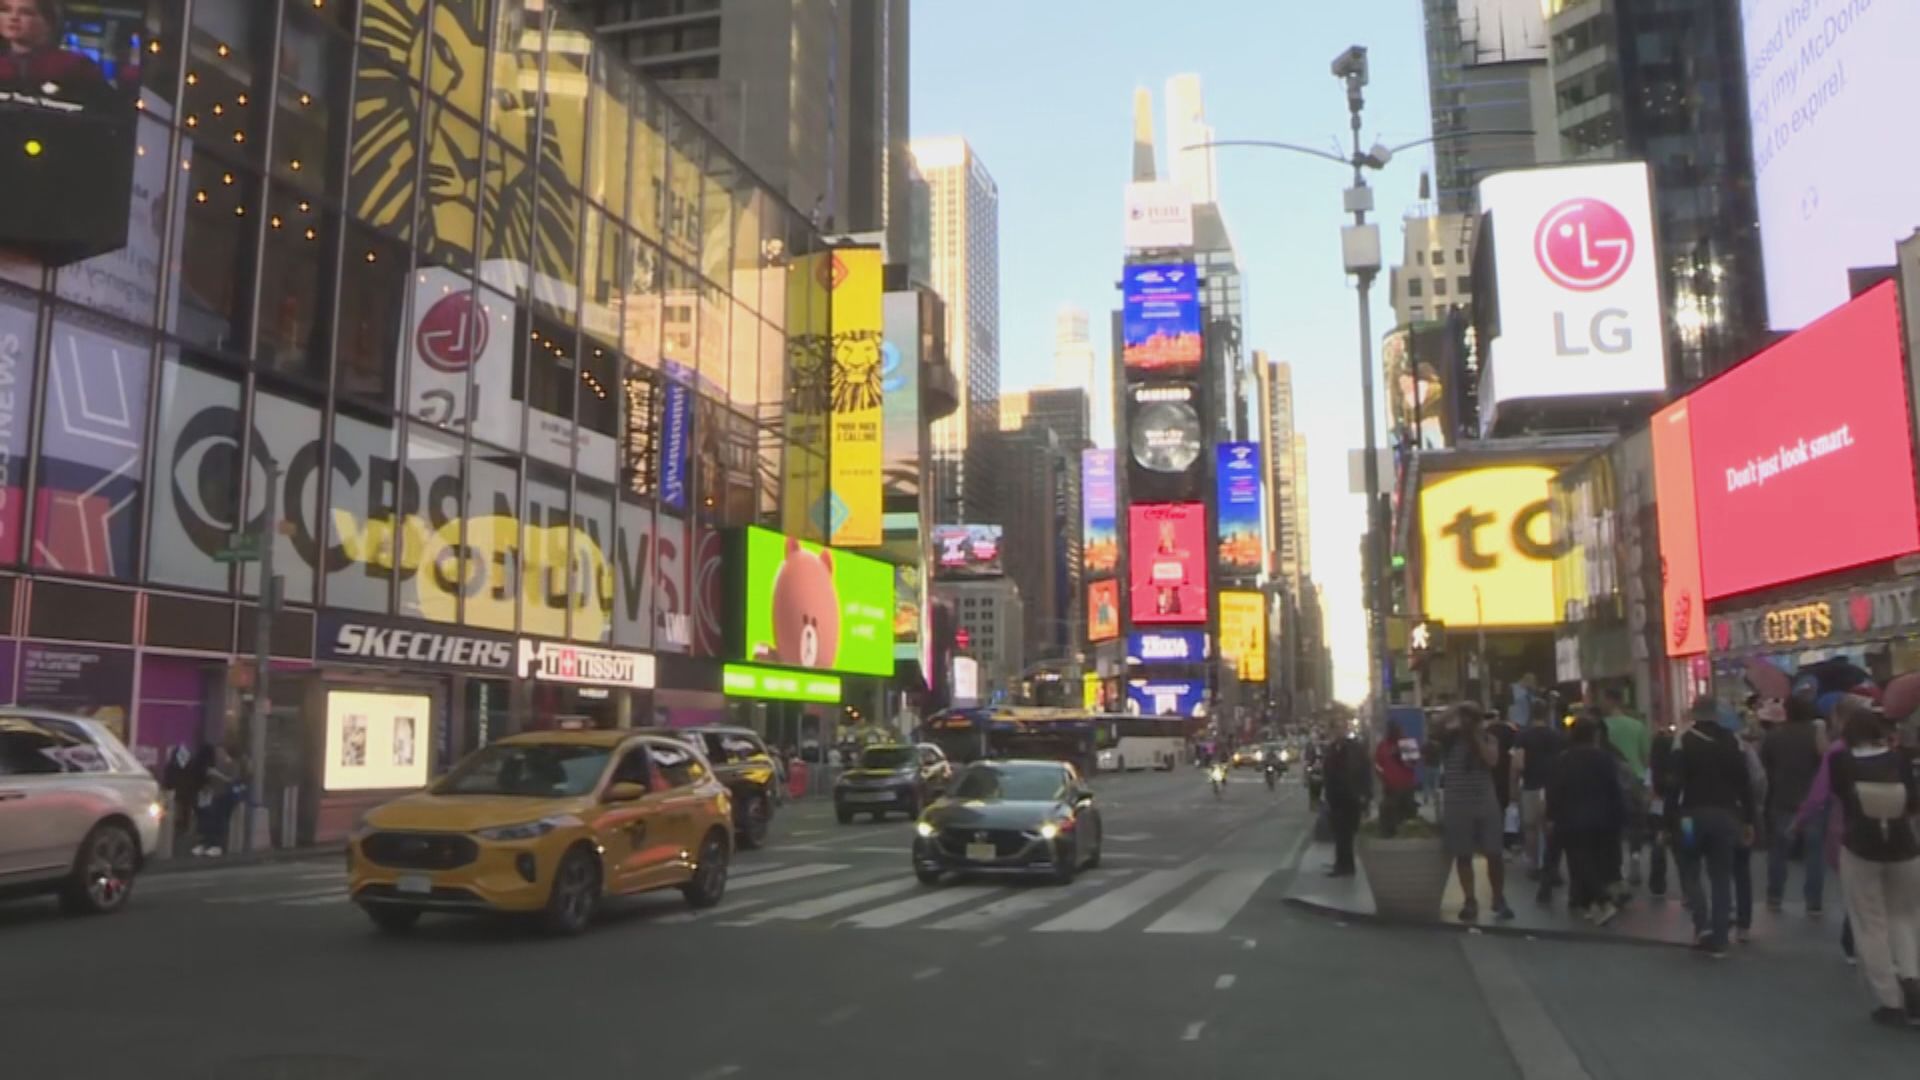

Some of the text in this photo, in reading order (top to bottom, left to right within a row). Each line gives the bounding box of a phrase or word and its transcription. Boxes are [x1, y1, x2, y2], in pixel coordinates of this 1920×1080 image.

[1784, 3, 1812, 39] the
[1774, 122, 1790, 151] to
[1553, 308, 1634, 357] LG
[1726, 423, 1855, 493] Don't just look smart.
[284, 439, 476, 588] CBS
[1765, 601, 1832, 643] GIFTS
[333, 623, 513, 670] SKECHERS
[578, 653, 634, 682] TISSOT
